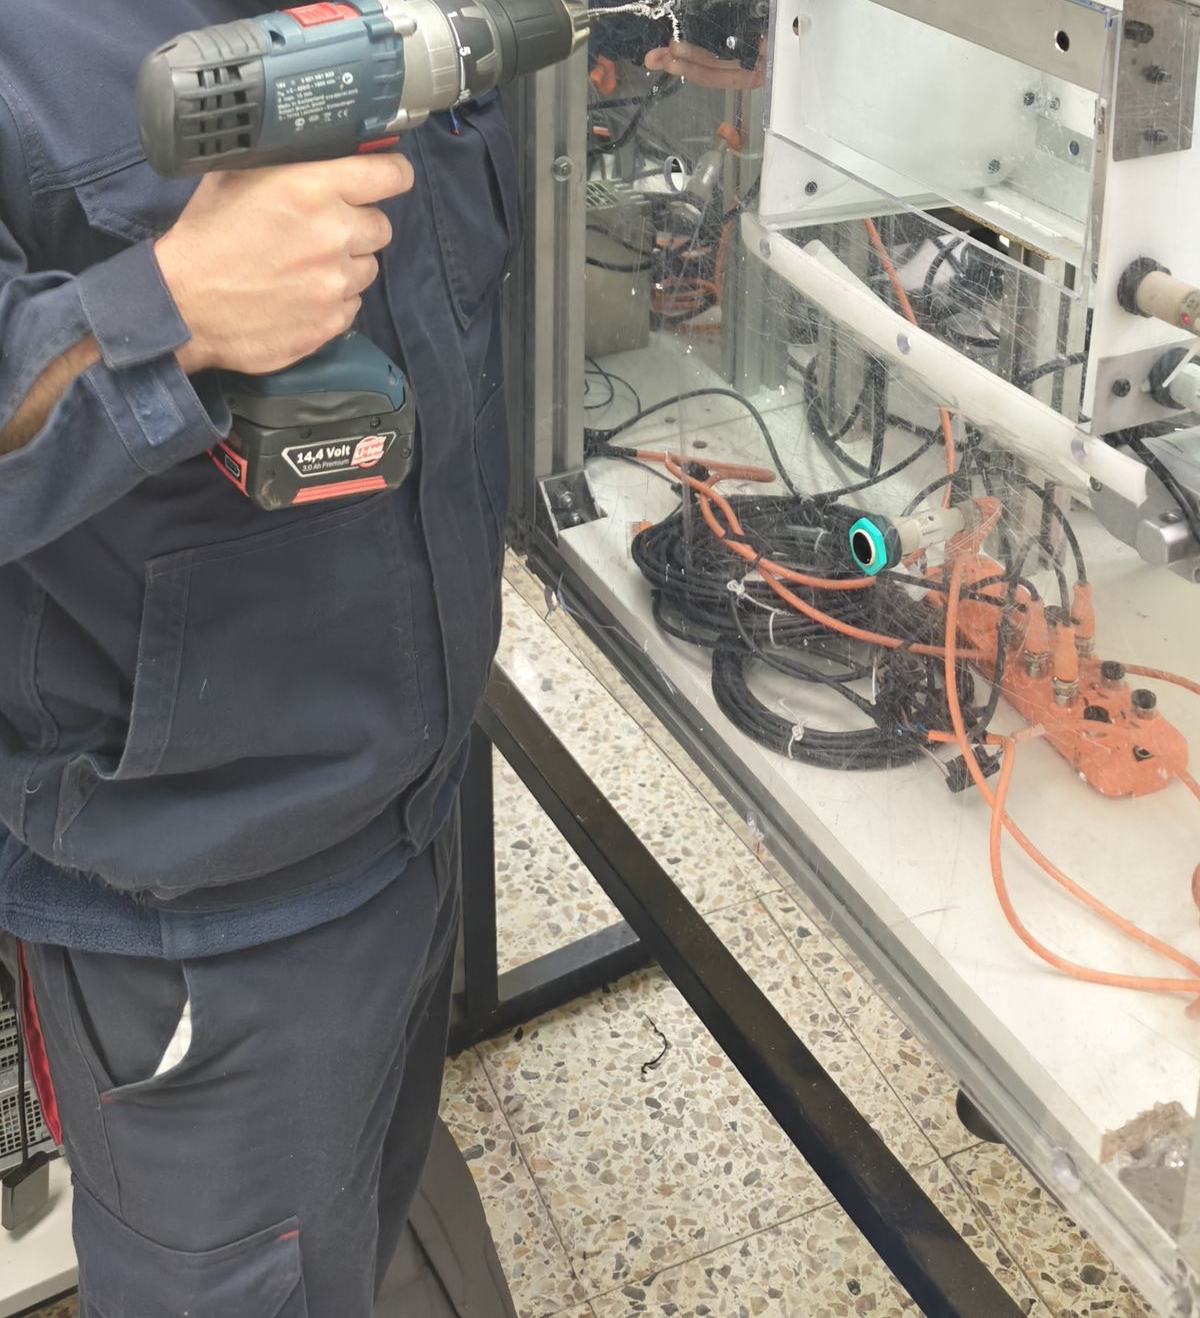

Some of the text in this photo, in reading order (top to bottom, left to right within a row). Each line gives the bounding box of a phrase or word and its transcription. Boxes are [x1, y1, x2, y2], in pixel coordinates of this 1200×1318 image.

[459, 46, 471, 57] 5
[296, 444, 350, 465] 14,4 Volt
[353, 447, 384, 459] Li-Ion
[313, 462, 322, 470] Ah
[322, 459, 349, 470] Premium
